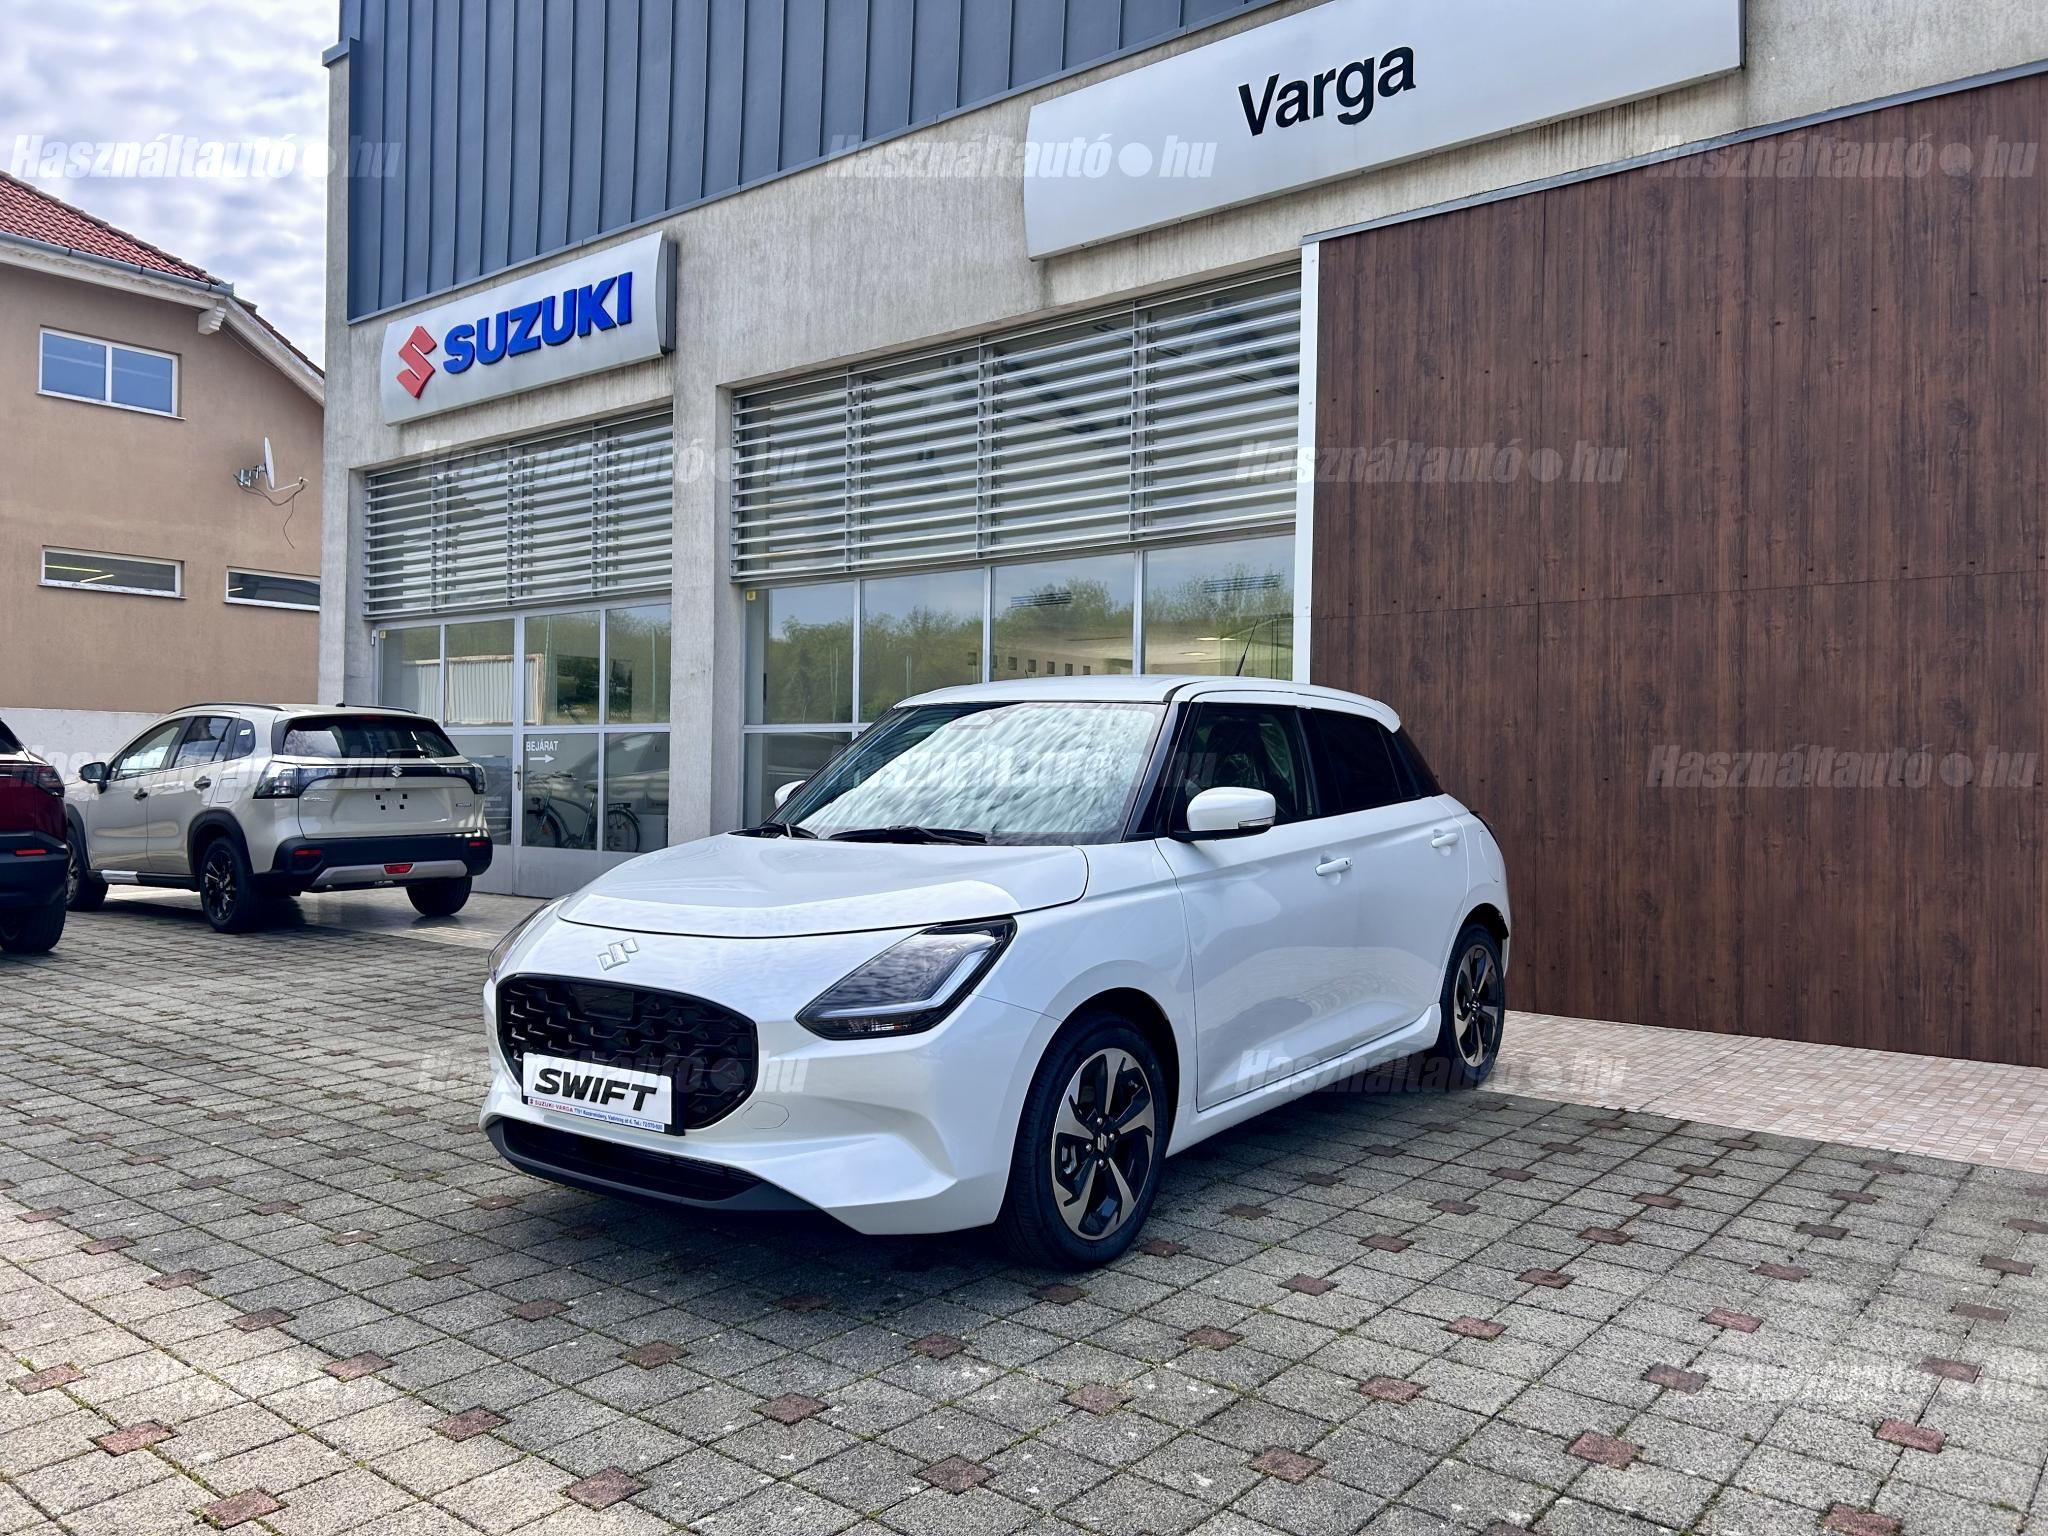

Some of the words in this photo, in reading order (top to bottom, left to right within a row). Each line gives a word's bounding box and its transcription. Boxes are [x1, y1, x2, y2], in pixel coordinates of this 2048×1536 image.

[1238, 46, 1416, 136] Varga
[443, 271, 632, 375] SUZUKI
[525, 738, 559, 752] BEJÁRAT
[534, 1067, 657, 1111] SWIFT
